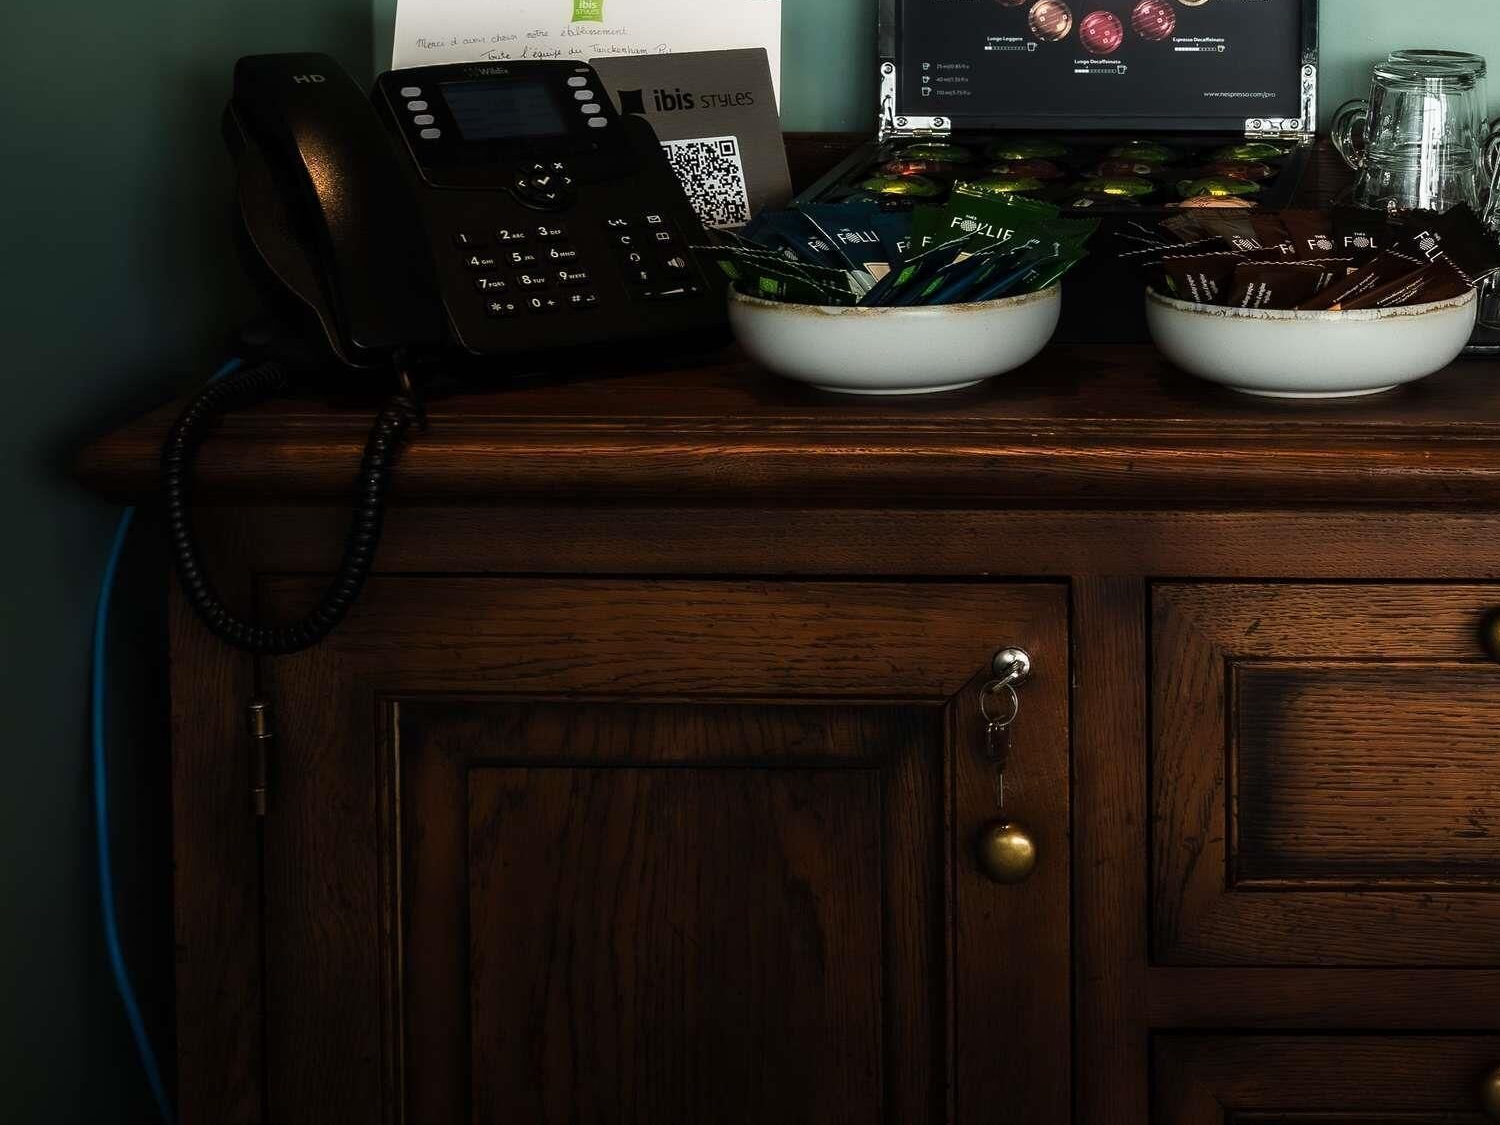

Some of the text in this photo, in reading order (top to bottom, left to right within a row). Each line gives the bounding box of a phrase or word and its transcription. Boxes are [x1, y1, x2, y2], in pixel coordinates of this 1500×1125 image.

[579, 0, 598, 9] ibis
[293, 74, 326, 84] HD
[653, 88, 696, 112] ibis
[460, 234, 467, 243] 1
[499, 230, 511, 240] 2
[538, 226, 548, 236] 3
[470, 256, 480, 266] 4
[512, 252, 522, 262] 5
[550, 248, 559, 258] 6
[479, 279, 488, 289] 7
[521, 275, 532, 285] 8
[559, 271, 568, 281] 9
[532, 298, 541, 308] 0
